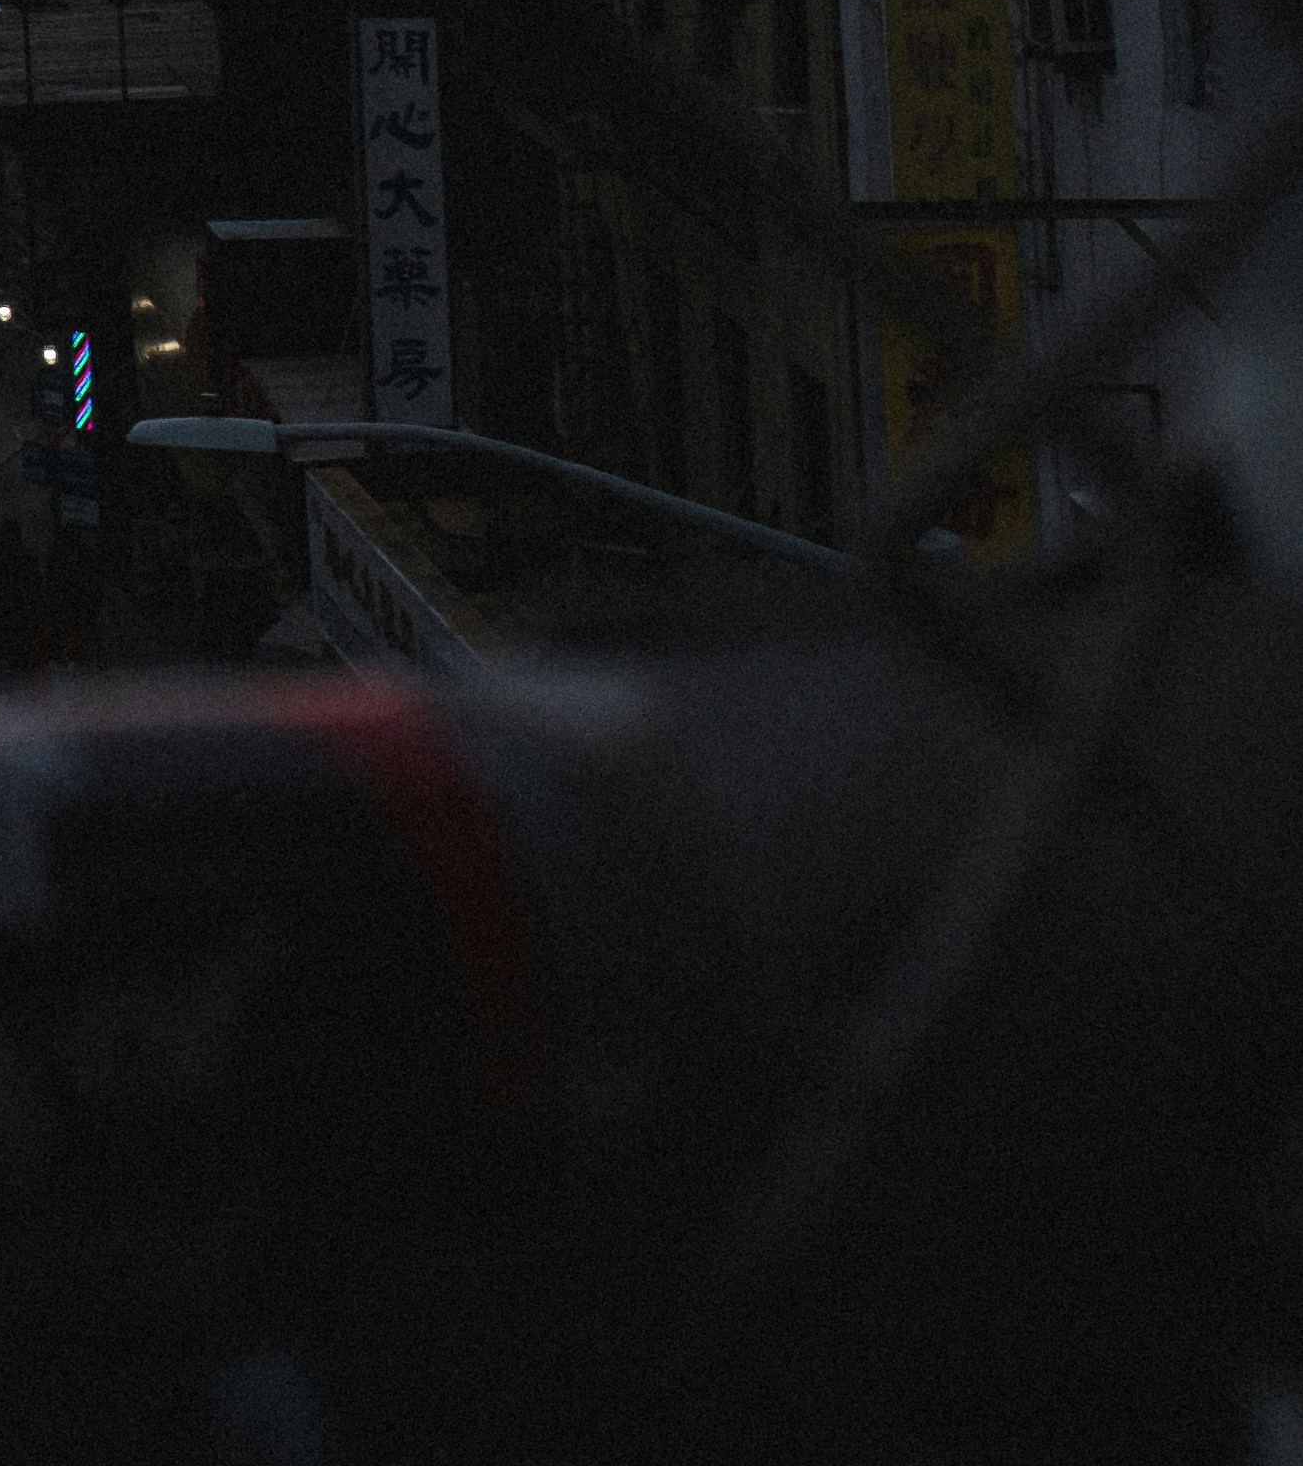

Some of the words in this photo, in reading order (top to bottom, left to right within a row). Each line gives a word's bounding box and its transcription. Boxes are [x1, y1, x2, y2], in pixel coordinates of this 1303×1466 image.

[368, 28, 442, 400] 開心大藥房
